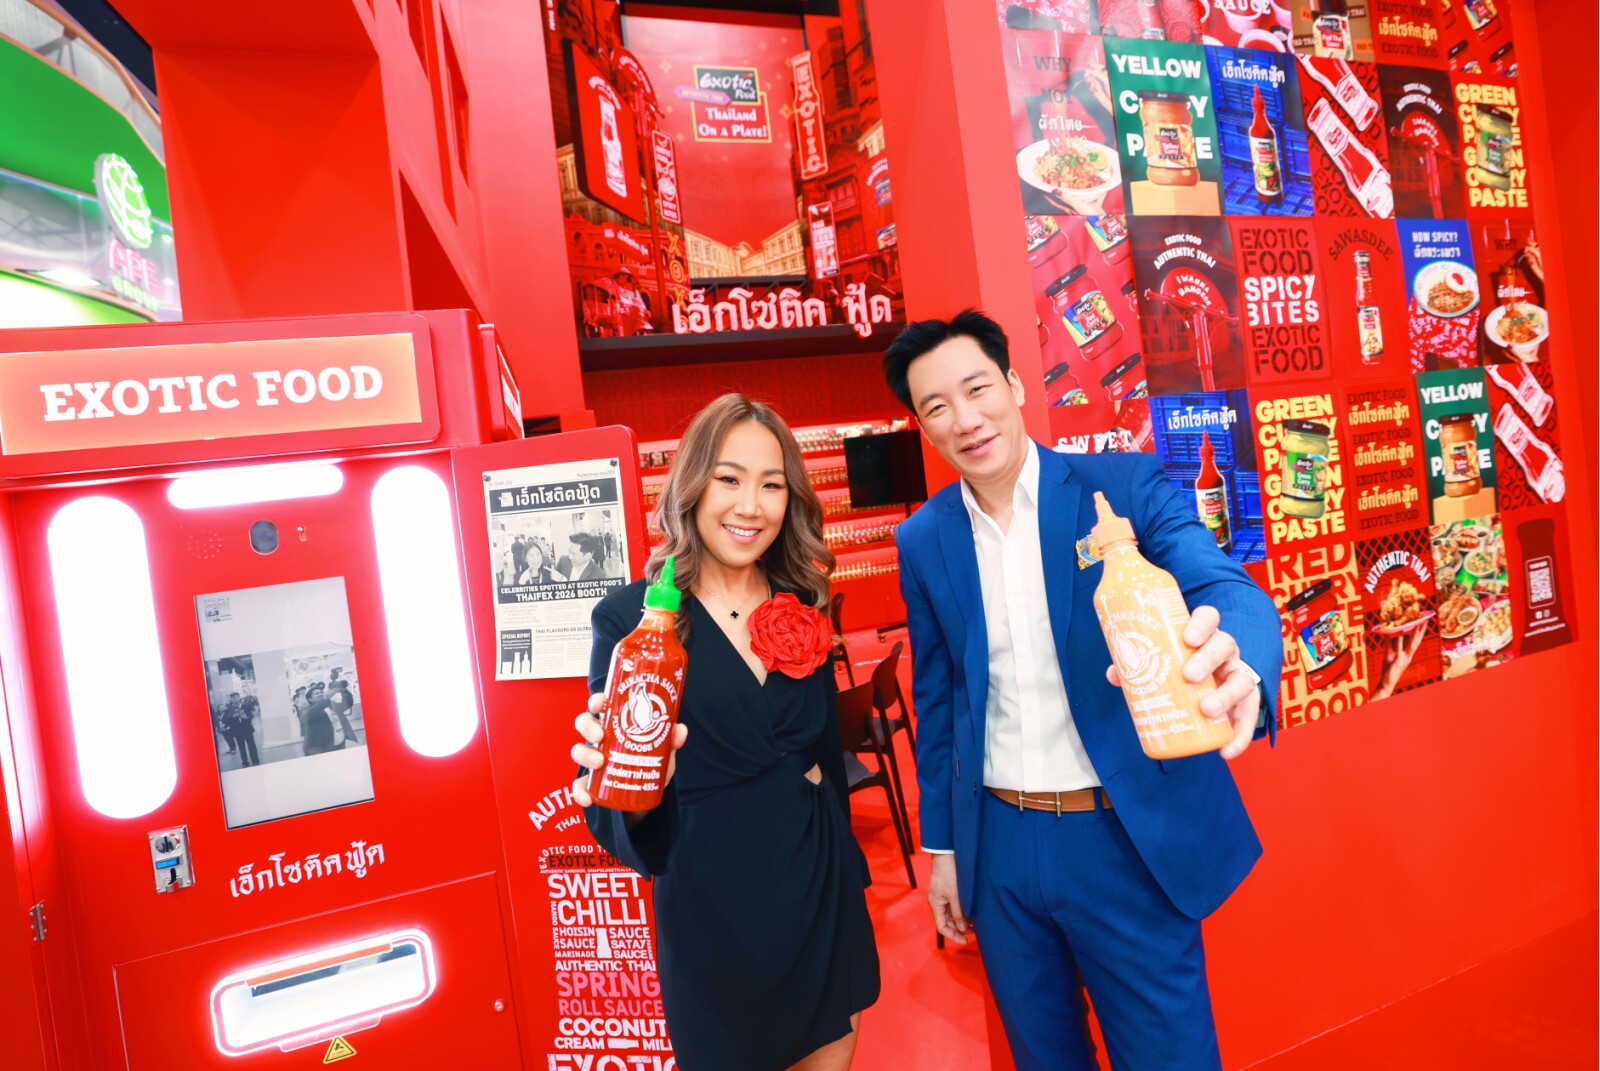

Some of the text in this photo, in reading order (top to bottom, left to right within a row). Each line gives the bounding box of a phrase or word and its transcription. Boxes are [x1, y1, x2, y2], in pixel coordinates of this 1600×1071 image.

[1033, 55, 1072, 73] WHY
[1111, 53, 1202, 79] YELLOW
[1222, 59, 1285, 88] เอ็กโซติคฟู้ด
[1455, 82, 1517, 106] GREEN
[796, 63, 822, 172] EXOTIC
[1469, 187, 1529, 208] PASTE
[1164, 234, 1202, 246] EXOTIC FOOD
[1239, 228, 1310, 250] EXOTIC
[1328, 228, 1393, 261] SAWASDEE
[1412, 231, 1459, 243] HOW SPICY?
[110, 239, 158, 294] APE
[1153, 246, 1217, 270] AUTHENTIC THAI
[1243, 250, 1314, 275] FOOD
[1180, 274, 1210, 293] WANNA
[1244, 274, 1316, 302] SPICY
[1177, 285, 1212, 307] BANGKOK
[671, 281, 892, 338] เอ็กโซติค ฟู้ด
[1246, 299, 1320, 327] BITES
[1251, 324, 1321, 348] EXOTIC
[1254, 345, 1324, 376] FOOD
[40, 365, 384, 422] EXOTIC FOOD
[1346, 388, 1407, 404] EXOTIC FOOD
[1420, 381, 1483, 404] YELLOW
[1167, 406, 1238, 431] เอ็กโซติคฟู้ด
[1255, 393, 1335, 424] GREEN
[1348, 401, 1410, 426] เอ็กโซติคฟู้ด
[1057, 430, 1133, 453] SWEET
[1352, 427, 1412, 446] EXOTIC FOOD
[1354, 441, 1414, 466] เอ็กโซติคฟู้ด
[1356, 471, 1389, 486] EXOTIC
[1390, 467, 1415, 481] FOOD
[515, 483, 600, 506] เอ็กโซติคฟู้ด
[1358, 484, 1419, 511] เอ็กโซติคฟู้ด
[1271, 509, 1346, 546] PASTE
[1360, 509, 1419, 530] EXOTIC FOOD
[1271, 543, 1351, 584] RED
[1364, 550, 1432, 594] AUTHENTIC THAI
[500, 585, 539, 594] CELEBRITIES
[539, 583, 567, 591] SPOTTED
[576, 581, 599, 589] EXOTIC
[516, 587, 608, 603] THAIFEX 2026 BOOTH
[1320, 636, 1331, 646] Red
[1320, 641, 1334, 653] Curry
[618, 673, 678, 702] SRIRACHA SAUCE
[1285, 685, 1369, 729] FOOD
[612, 715, 671, 752] FLYING GOOSE BRAND
[617, 756, 657, 765] ORIGINAL
[555, 815, 581, 832] THAI
[229, 839, 386, 898] เอ็กโซติคฟู้ด
[538, 845, 594, 870] EXOTIC FOOD
[549, 854, 623, 868] EXOTIC FOO
[547, 872, 643, 899] SWEET
[557, 899, 647, 925] CHILLI
[552, 927, 560, 950] SAUCE
[559, 927, 596, 938] HOISIN
[560, 938, 596, 949] SAUCE
[609, 927, 651, 939] SAUCE
[611, 940, 648, 950] SATAY
[613, 950, 648, 959] SAUCE
[555, 960, 657, 972] AUTHENTIC THAI
[556, 971, 661, 998] SPRING
[558, 999, 665, 1017] ROLL SAUCE
[558, 1017, 667, 1037] COCONUT
[554, 1036, 605, 1050] CREAM
